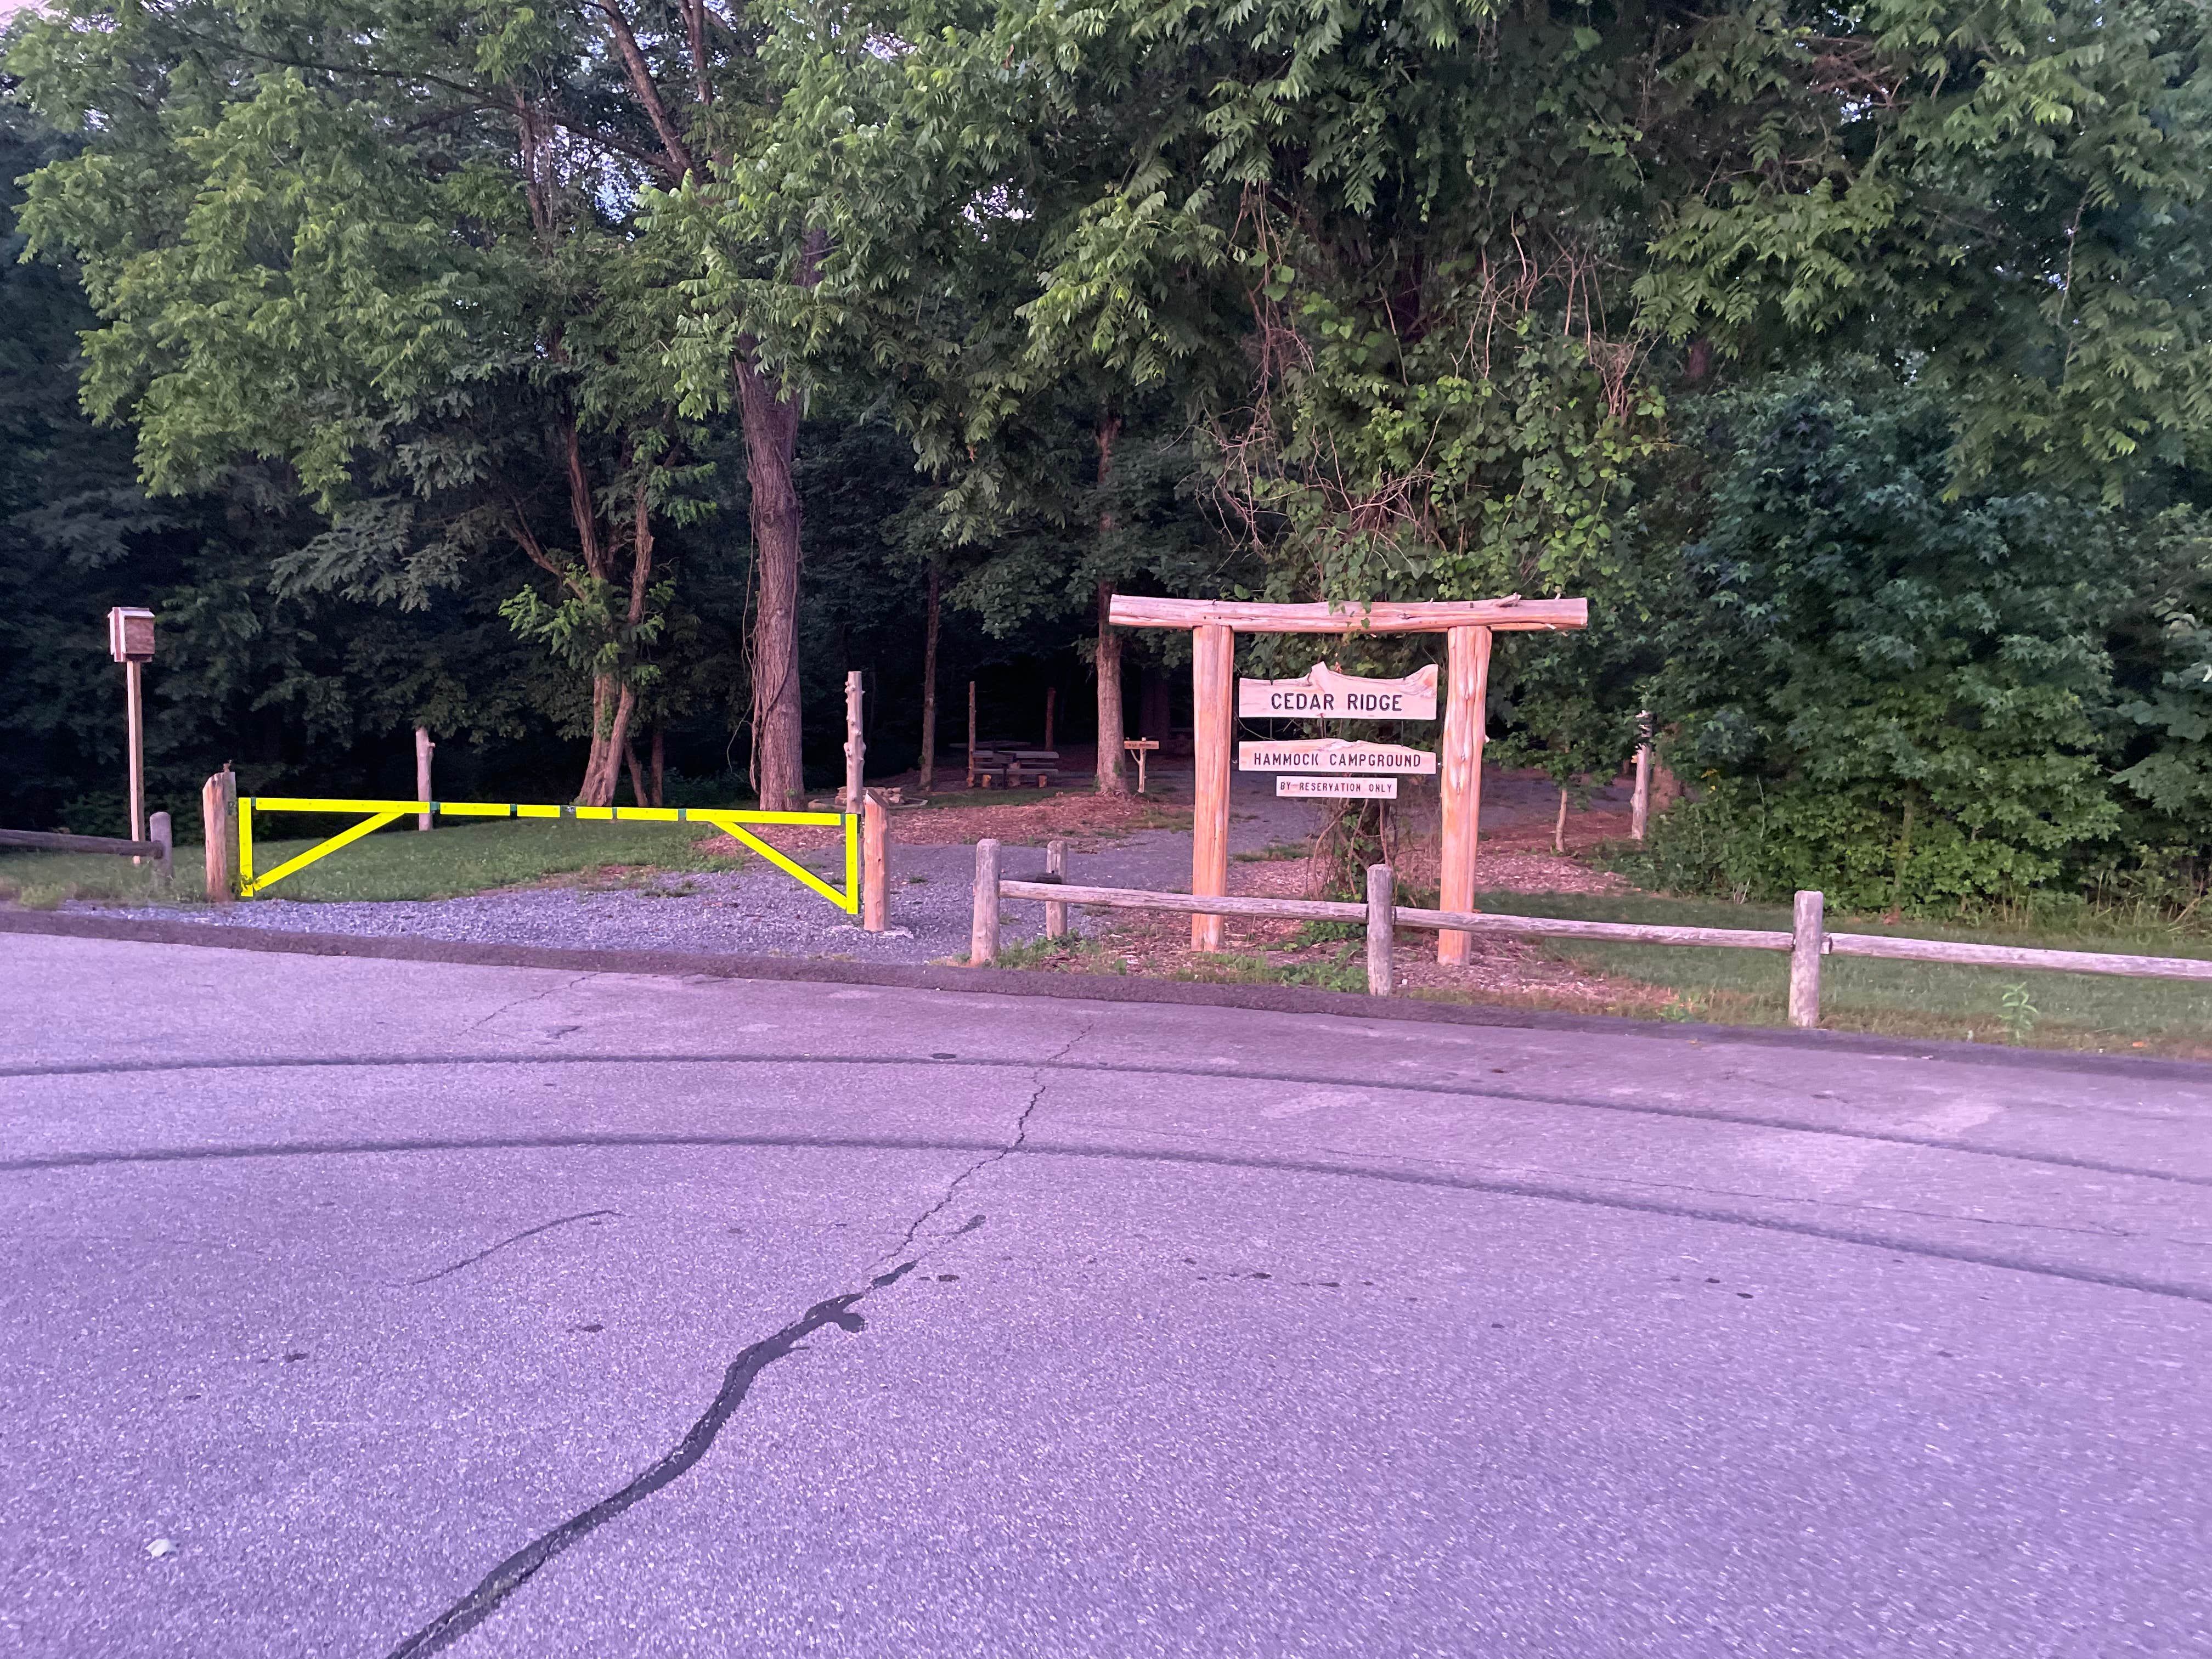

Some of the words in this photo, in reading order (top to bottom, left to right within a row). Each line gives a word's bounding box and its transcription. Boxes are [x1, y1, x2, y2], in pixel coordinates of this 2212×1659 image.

[1271, 693, 1334, 710] CEDAR
[1347, 693, 1403, 712] RIDGE
[1254, 753, 1318, 766] HAMMOCK
[1329, 753, 1421, 767] CAMPGROUND
[1280, 782, 1291, 791] BY
[1299, 782, 1361, 792] RESERVATION
[1369, 783, 1392, 793] ONLY
